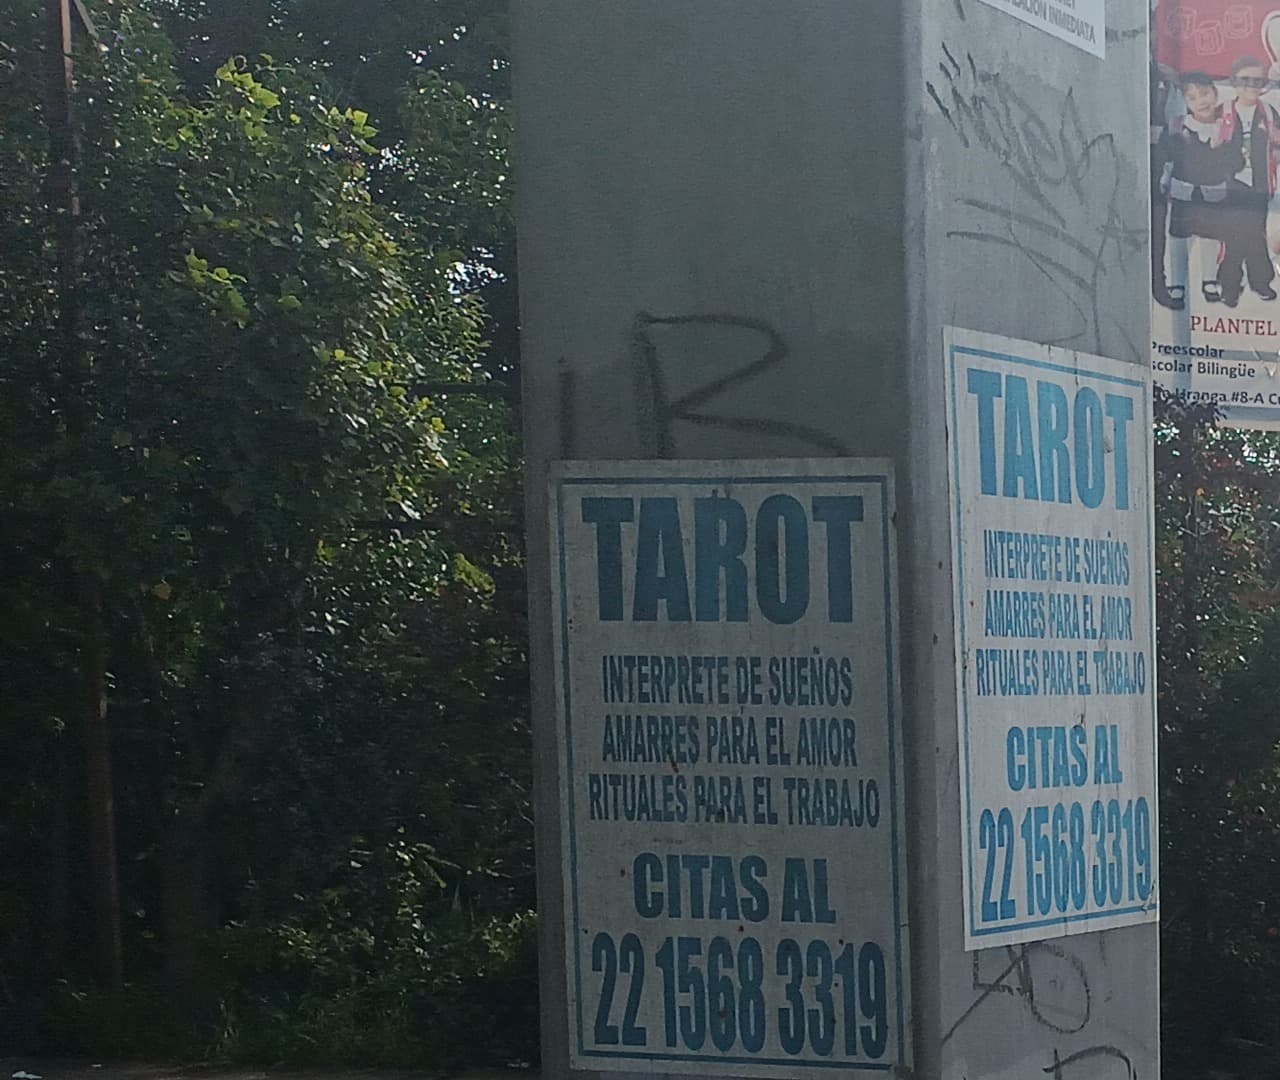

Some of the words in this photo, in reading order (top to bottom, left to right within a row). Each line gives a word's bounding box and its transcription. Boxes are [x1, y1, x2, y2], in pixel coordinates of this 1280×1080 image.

[1191, 316, 1278, 338] PLANTEL
[1197, 361, 1256, 383] Bilingüe
[1231, 391, 1264, 406] #8-A
[967, 367, 1134, 511] TAROT
[581, 493, 865, 625] TAROT
[983, 528, 1062, 582] INTERPRETE
[1066, 536, 1081, 583] DE
[1084, 530, 1130, 587] SUEÑOS
[984, 589, 1045, 640] AMARRES
[1049, 592, 1081, 640] PARA
[1083, 595, 1098, 641] EL
[1100, 595, 1134, 642] AMOR
[602, 654, 729, 706] INTERPRETE
[736, 657, 763, 706] DE
[769, 647, 853, 708] SUEÑOS
[976, 648, 1040, 697] RITUALES
[1043, 650, 1075, 697] PARA
[1077, 651, 1091, 696] EL
[1093, 649, 1146, 697] TRABAJO
[602, 714, 700, 766] AMARRES
[706, 716, 760, 766] PARA
[766, 717, 791, 767] EL
[797, 717, 858, 768] AMOR
[1006, 724, 1088, 792] CITAS
[1094, 723, 1124, 787] AL
[588, 773, 688, 825] RITUALES
[694, 775, 748, 826] PARA
[753, 776, 779, 827] EL
[783, 776, 881, 829] TRABAJO
[632, 852, 770, 923] CITAS
[781, 857, 837, 925] AL
[980, 806, 1015, 924] 22
[1020, 800, 1085, 918] 1568
[1091, 795, 1152, 910] 3319
[591, 931, 647, 1049] 22
[655, 934, 767, 1055] 1568
[776, 937, 889, 1060] 3319
